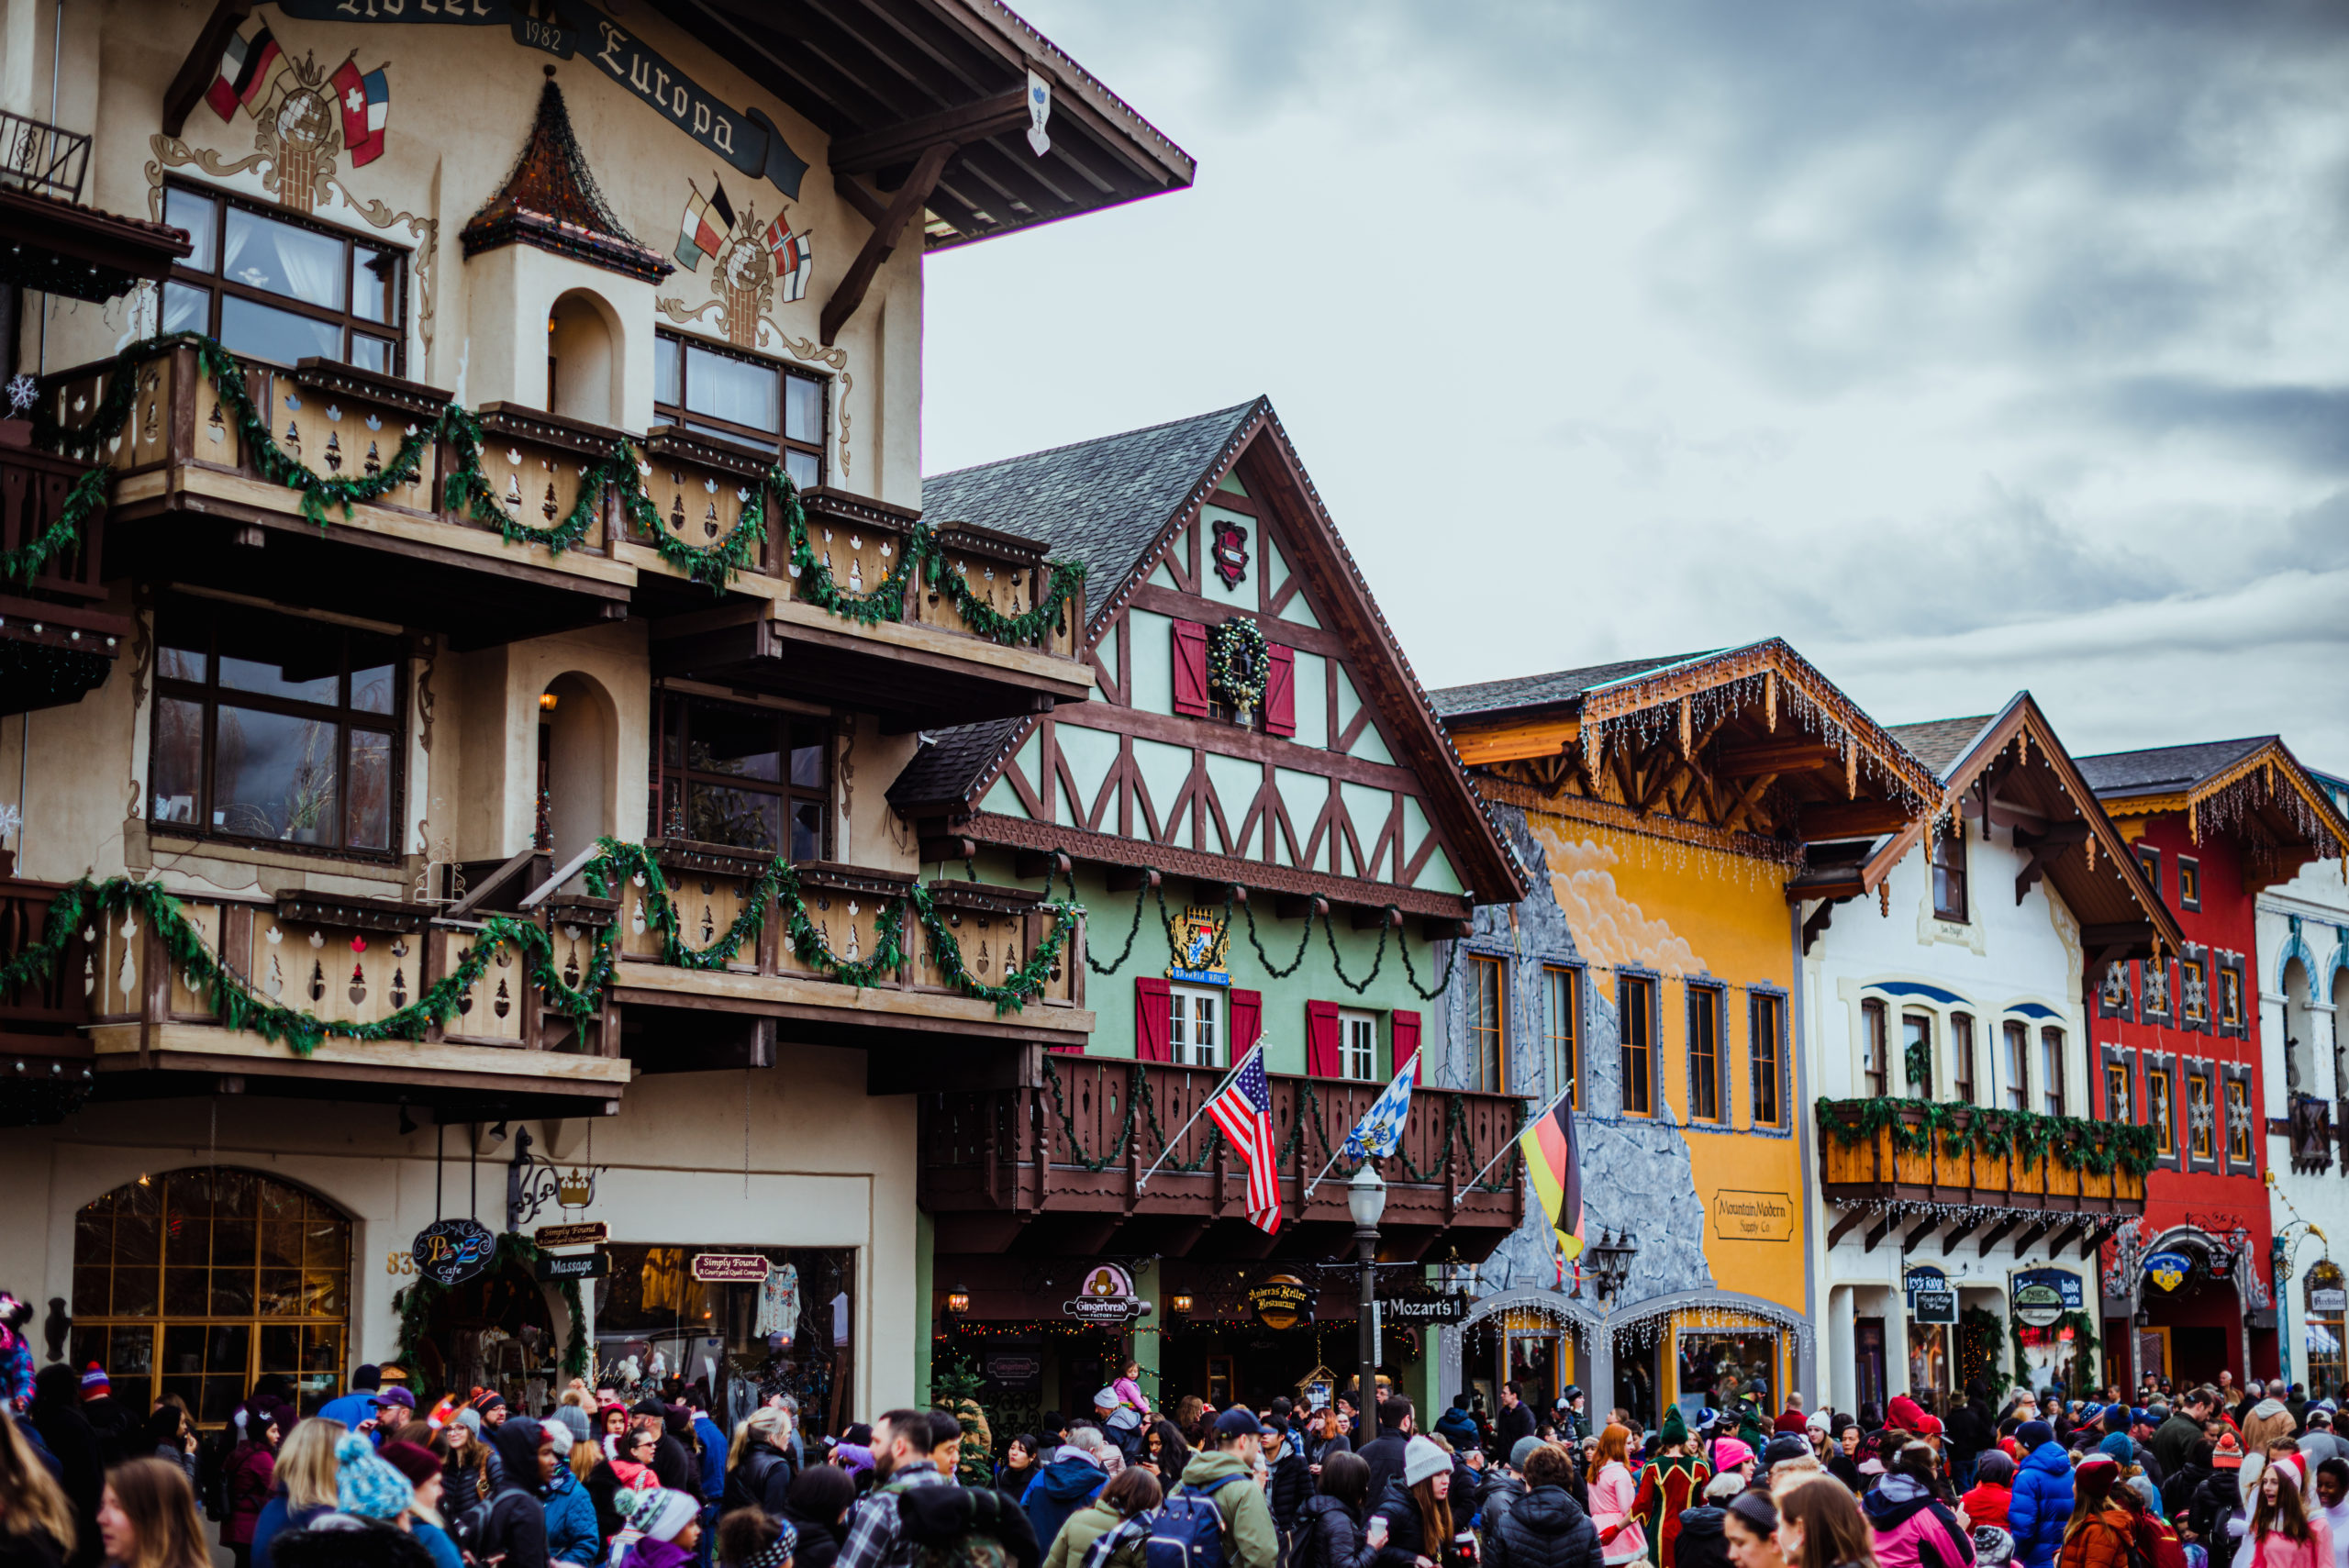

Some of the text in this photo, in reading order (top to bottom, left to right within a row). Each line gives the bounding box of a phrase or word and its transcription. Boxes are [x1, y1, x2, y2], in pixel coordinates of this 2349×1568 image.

[526, 20, 561, 50] 1982
[597, 20, 734, 155] Europa
[1175, 969, 1227, 984] BAVARIA HAUS
[1719, 1199, 1786, 1218] Mountain Modern
[545, 1223, 596, 1239] Simply Found
[1740, 1219, 1758, 1234] Supply
[551, 1260, 593, 1276] Massage
[704, 1258, 759, 1270] Simply Found
[2210, 1259, 2229, 1269] Kettle
[437, 1263, 462, 1283] Cafe
[705, 1268, 729, 1276] Courtyard
[743, 1269, 764, 1277] Company
[1248, 1284, 1307, 1301] Andreas Keller
[2061, 1278, 2079, 1294] Inside
[1076, 1301, 1128, 1313] Gingerbread
[1257, 1298, 1296, 1310] Restaurant
[1389, 1298, 1452, 1318] Mozart's
[2314, 1296, 2345, 1308] Architect
